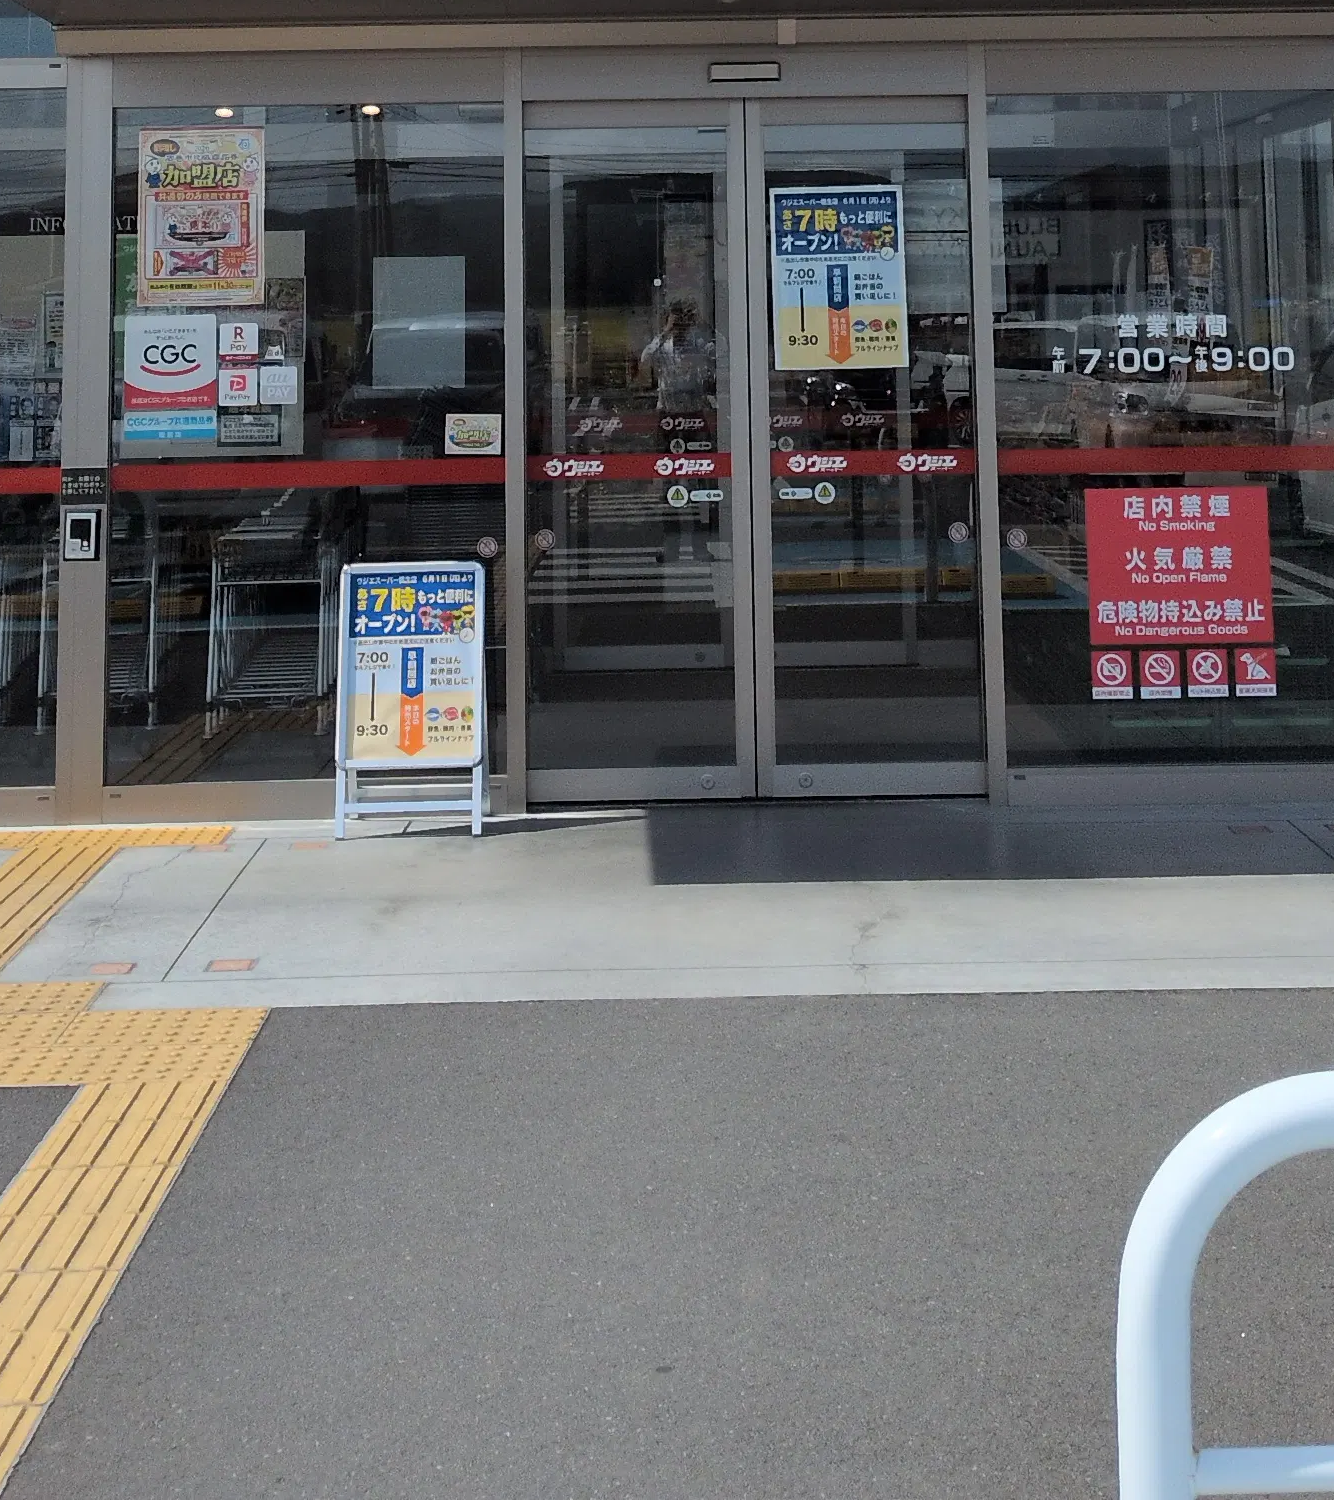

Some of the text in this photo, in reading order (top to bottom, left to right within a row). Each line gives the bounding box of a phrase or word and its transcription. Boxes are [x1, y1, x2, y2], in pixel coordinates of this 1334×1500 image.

[162, 162, 240, 188] 加盟店
[795, 208, 838, 232] 7時
[840, 210, 893, 224] もっと便利に
[785, 268, 815, 279] 7:00
[233, 326, 245, 340] R
[1118, 314, 1227, 338] 営業時間
[230, 343, 248, 352] Pay
[788, 335, 818, 346] 9:30
[143, 344, 197, 364] CGC
[1052, 346, 1065, 373] 午前
[224, 393, 251, 402] PayPay
[267, 387, 292, 398] PAY
[563, 459, 605, 476] ウジエ
[673, 457, 715, 475] ウジエ
[806, 454, 847, 472] ウジエ
[916, 453, 958, 471] ウジエ
[1123, 494, 1231, 519] 店内禁煙
[1139, 519, 1216, 532] No Smoking
[1125, 546, 1233, 571] 火気厳禁
[1131, 571, 1227, 584] No Open Flame
[370, 587, 416, 612] 7時
[417, 589, 474, 604] もっと便利に
[1097, 598, 1265, 624] 危険物持込み禁止
[1115, 623, 1248, 637] No Dangerous Goods
[357, 652, 389, 663] 7:00
[356, 724, 388, 736] 9:30
